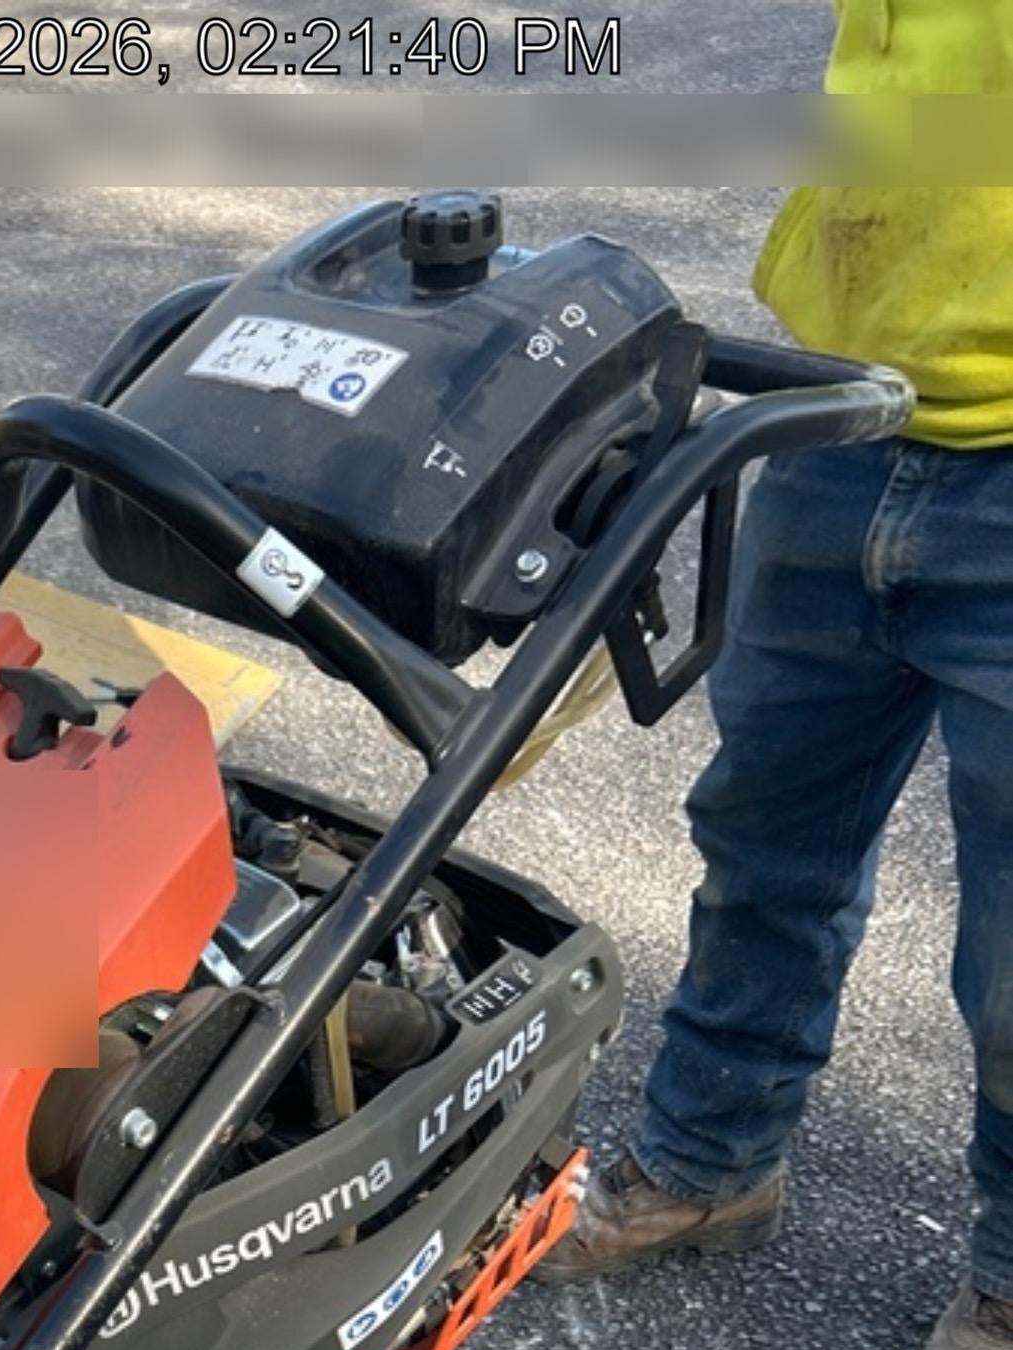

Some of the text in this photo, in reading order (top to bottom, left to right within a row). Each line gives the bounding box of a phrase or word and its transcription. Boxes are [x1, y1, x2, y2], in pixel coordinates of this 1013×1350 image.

[418, 1009, 546, 1154] LT 6005
[140, 1157, 393, 1306] Husqvarna
